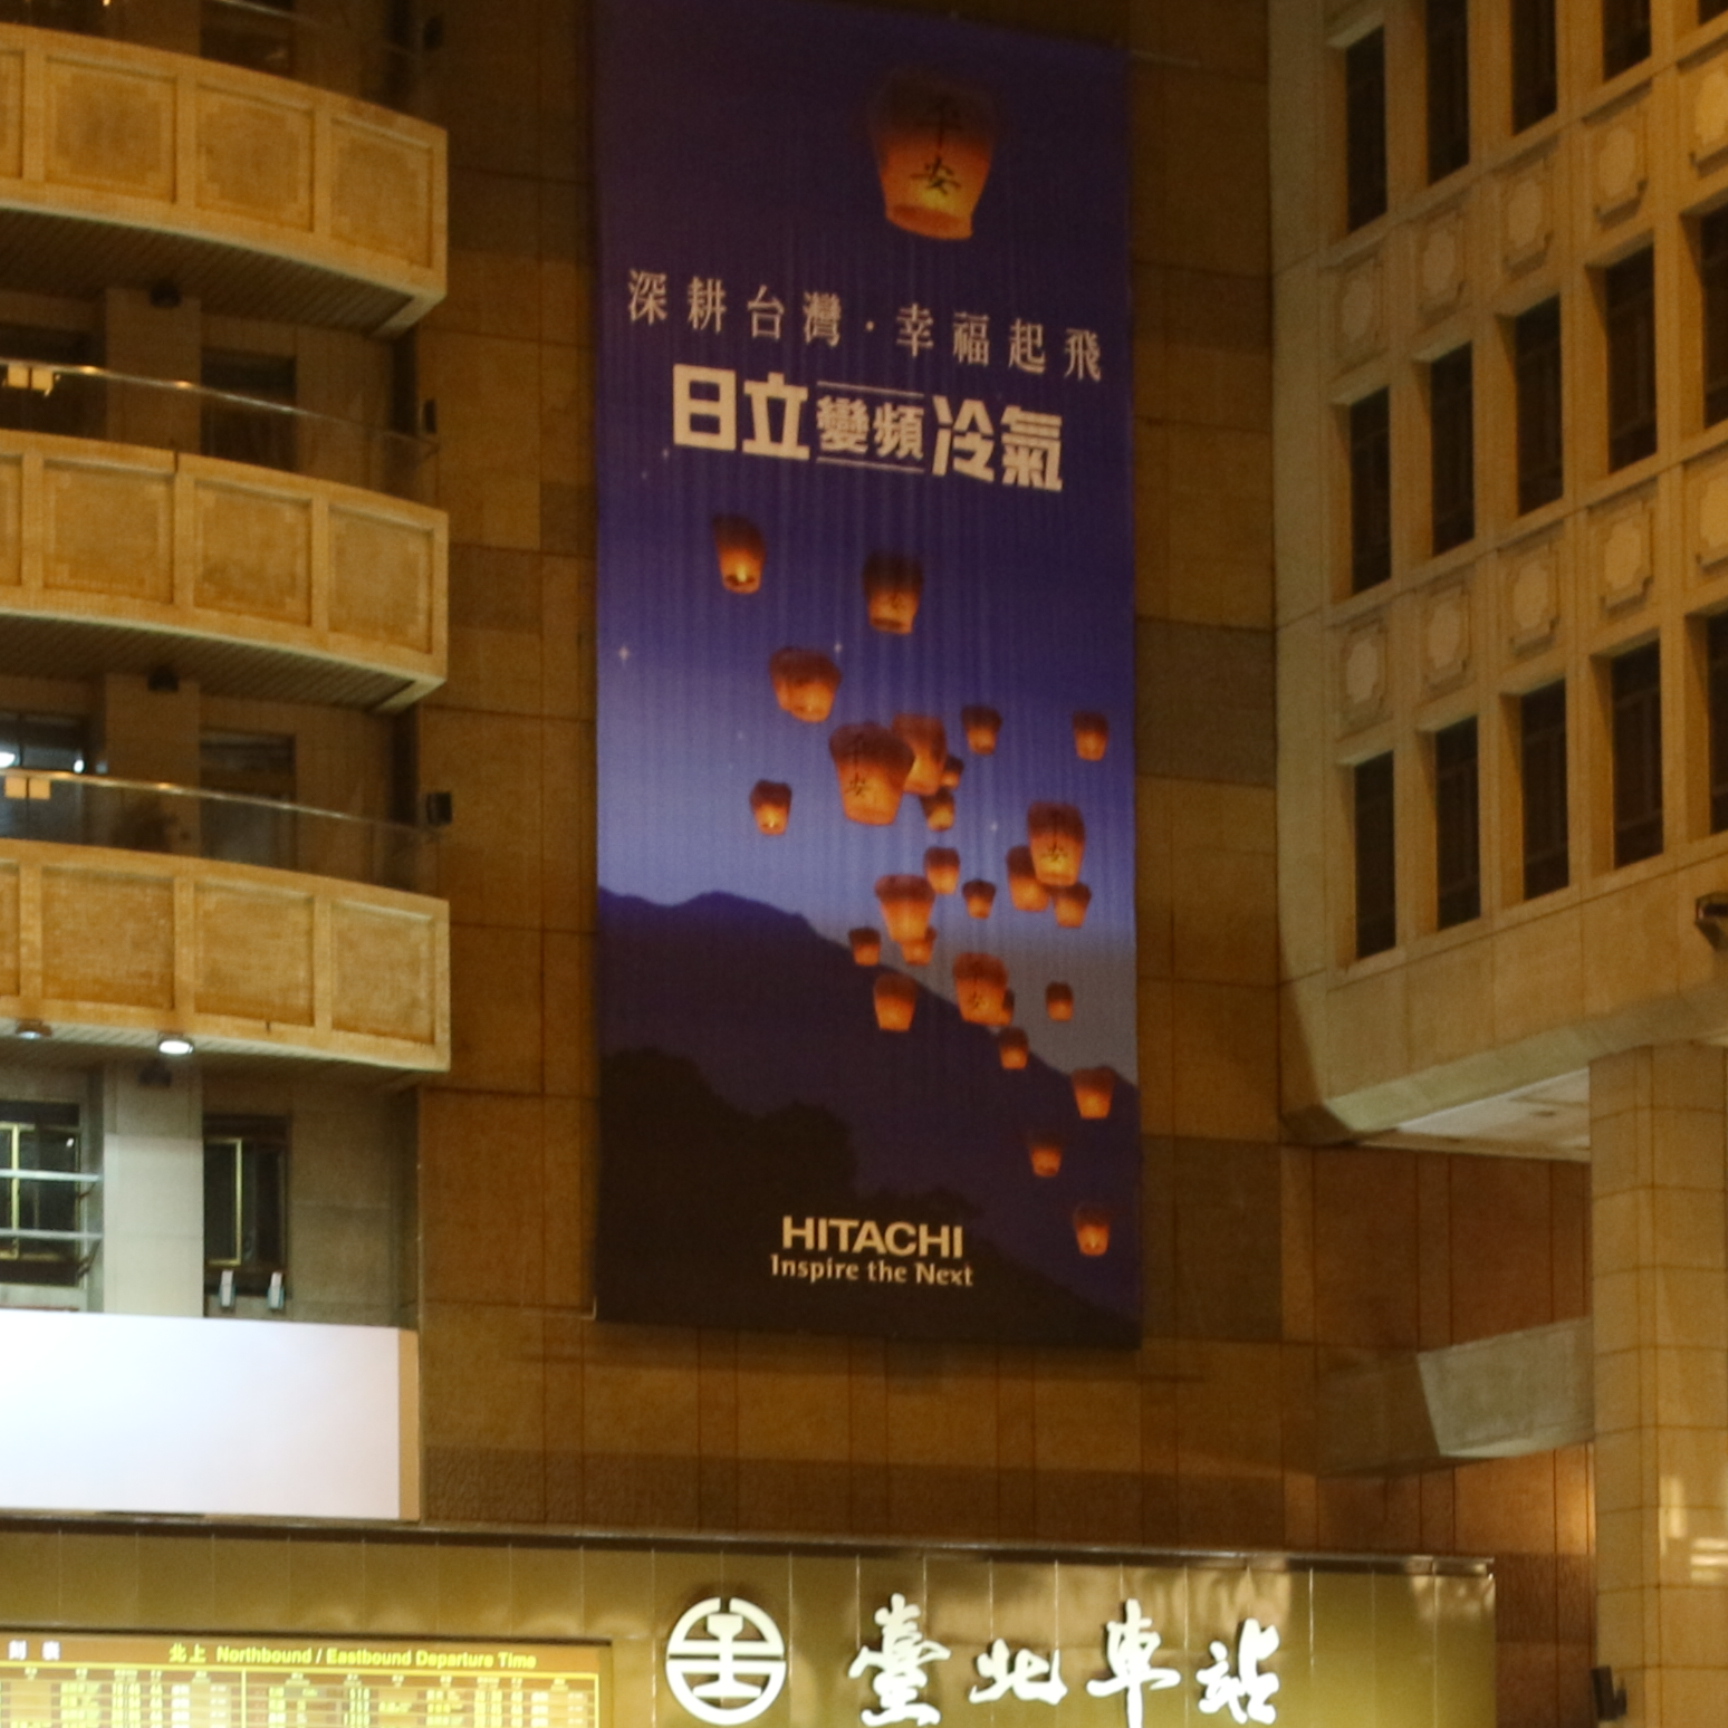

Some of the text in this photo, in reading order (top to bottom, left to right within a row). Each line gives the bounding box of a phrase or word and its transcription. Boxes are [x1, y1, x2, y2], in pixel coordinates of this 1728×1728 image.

[673, 363, 1063, 492] 日立變頻冷氣
[781, 1215, 964, 1258] HITACHI
[770, 1253, 974, 1287] Inspire the Next
[168, 1642, 207, 1664] 北上
[216, 1645, 312, 1666] Northbound
[326, 1648, 412, 1667] Eastbound
[416, 1650, 494, 1670] Departure
[498, 1651, 538, 1669] Time
